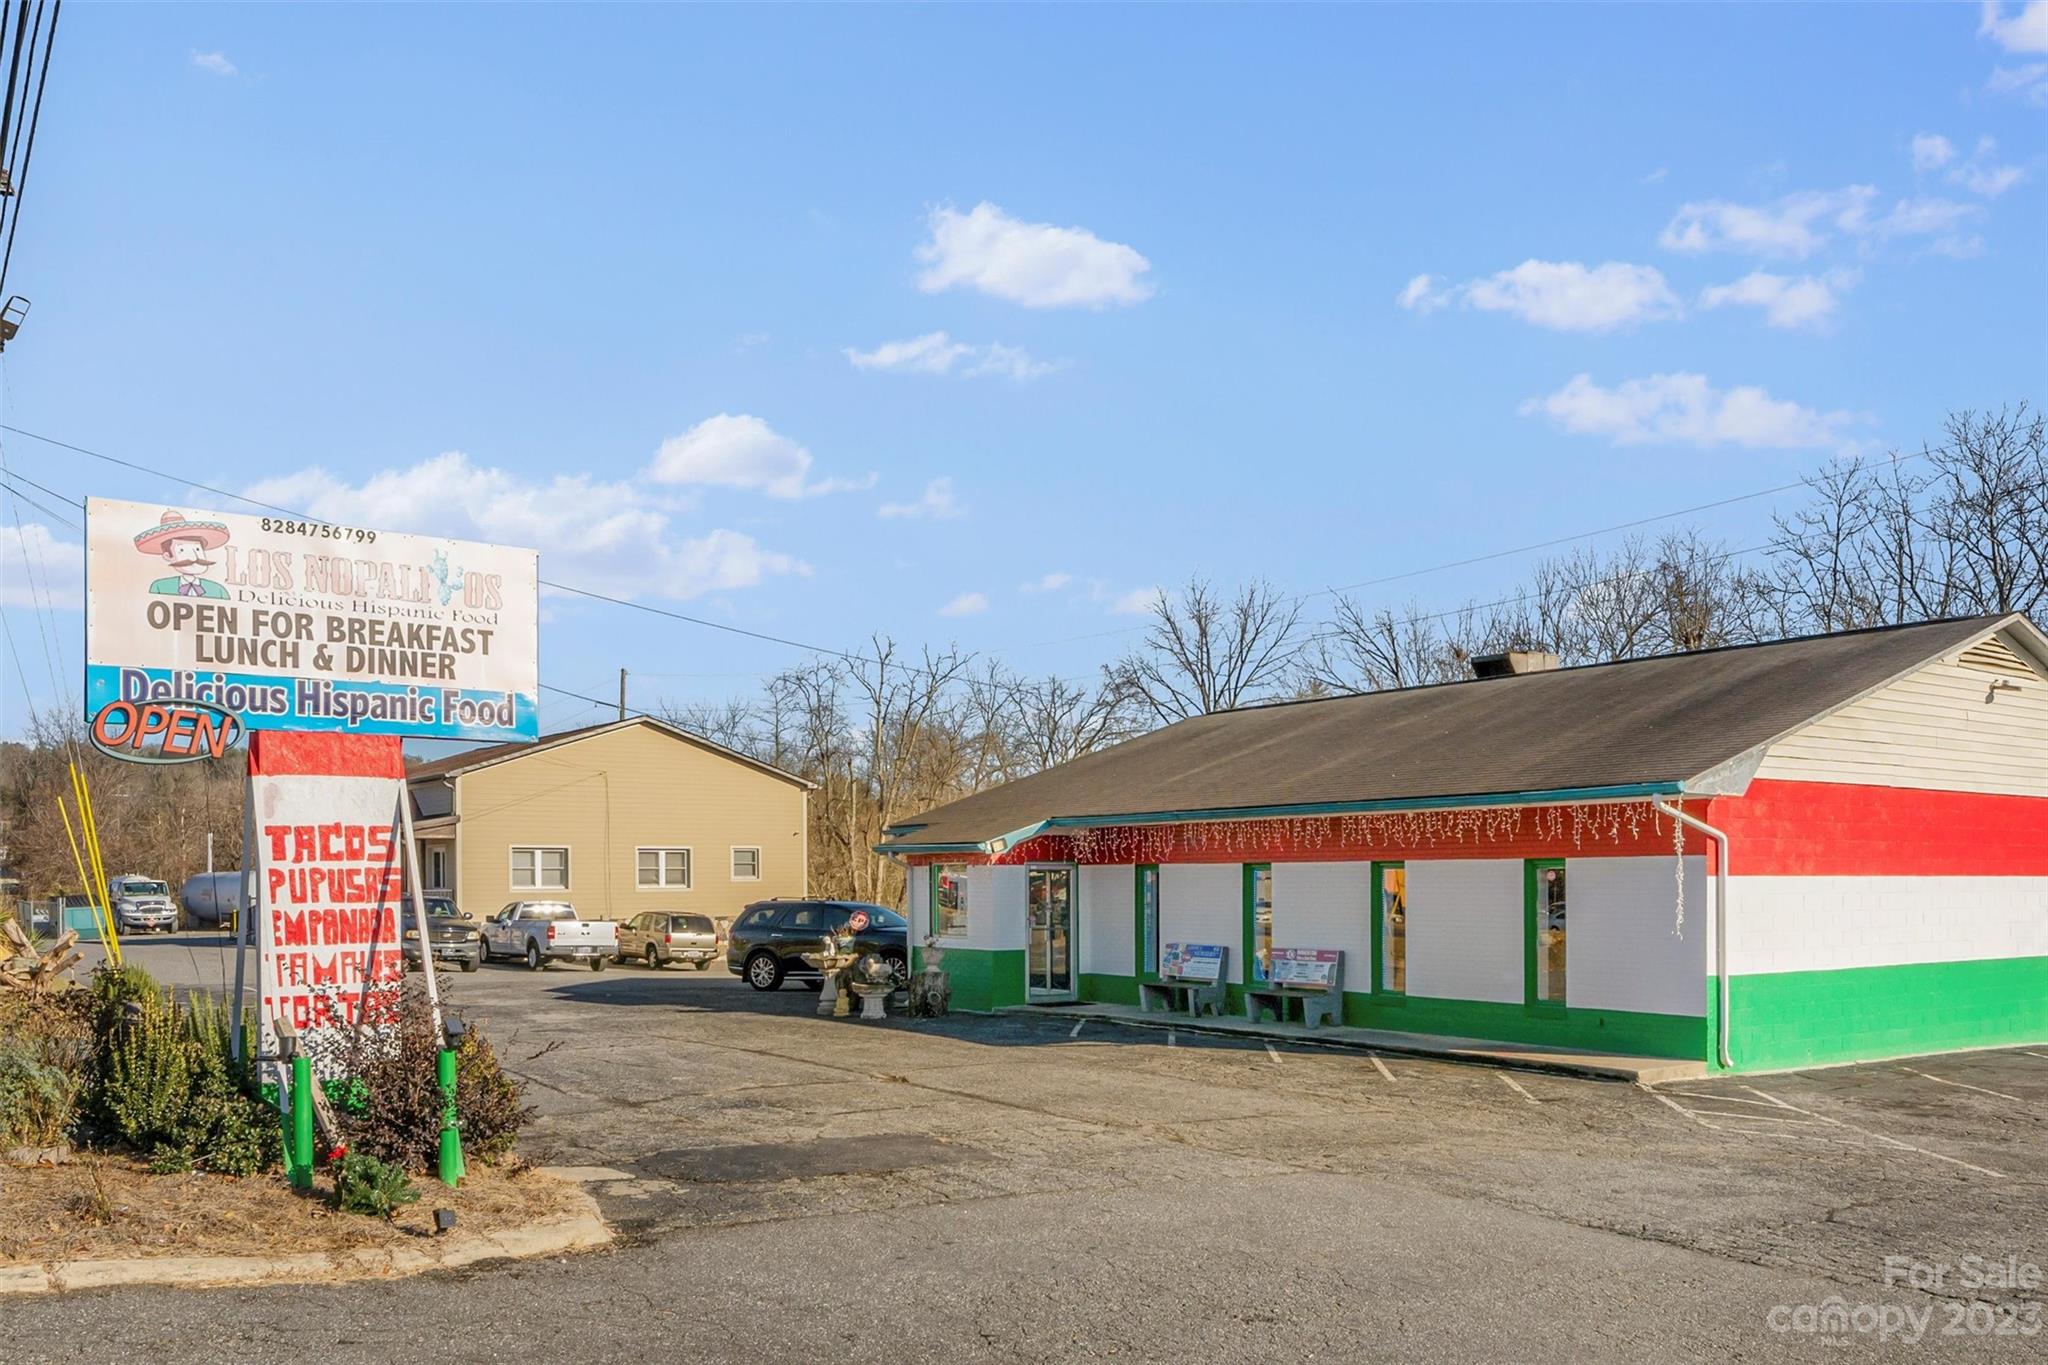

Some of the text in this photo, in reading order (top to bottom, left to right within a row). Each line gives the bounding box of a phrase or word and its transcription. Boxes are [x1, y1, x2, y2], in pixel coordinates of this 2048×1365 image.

[261, 517, 377, 544] 8284756799
[224, 545, 294, 591] LOS
[147, 600, 494, 656] OPEN FOR BREAKFAST
[238, 589, 498, 625] Delicious Hispanic Food
[196, 634, 457, 680] LUNCH & DINNER
[121, 668, 516, 728] Delicious Hispanic Food
[94, 701, 234, 759] OPEN
[264, 822, 397, 864] TACOS
[268, 867, 401, 904] PUPUSAS
[271, 907, 397, 947] EMPANADA
